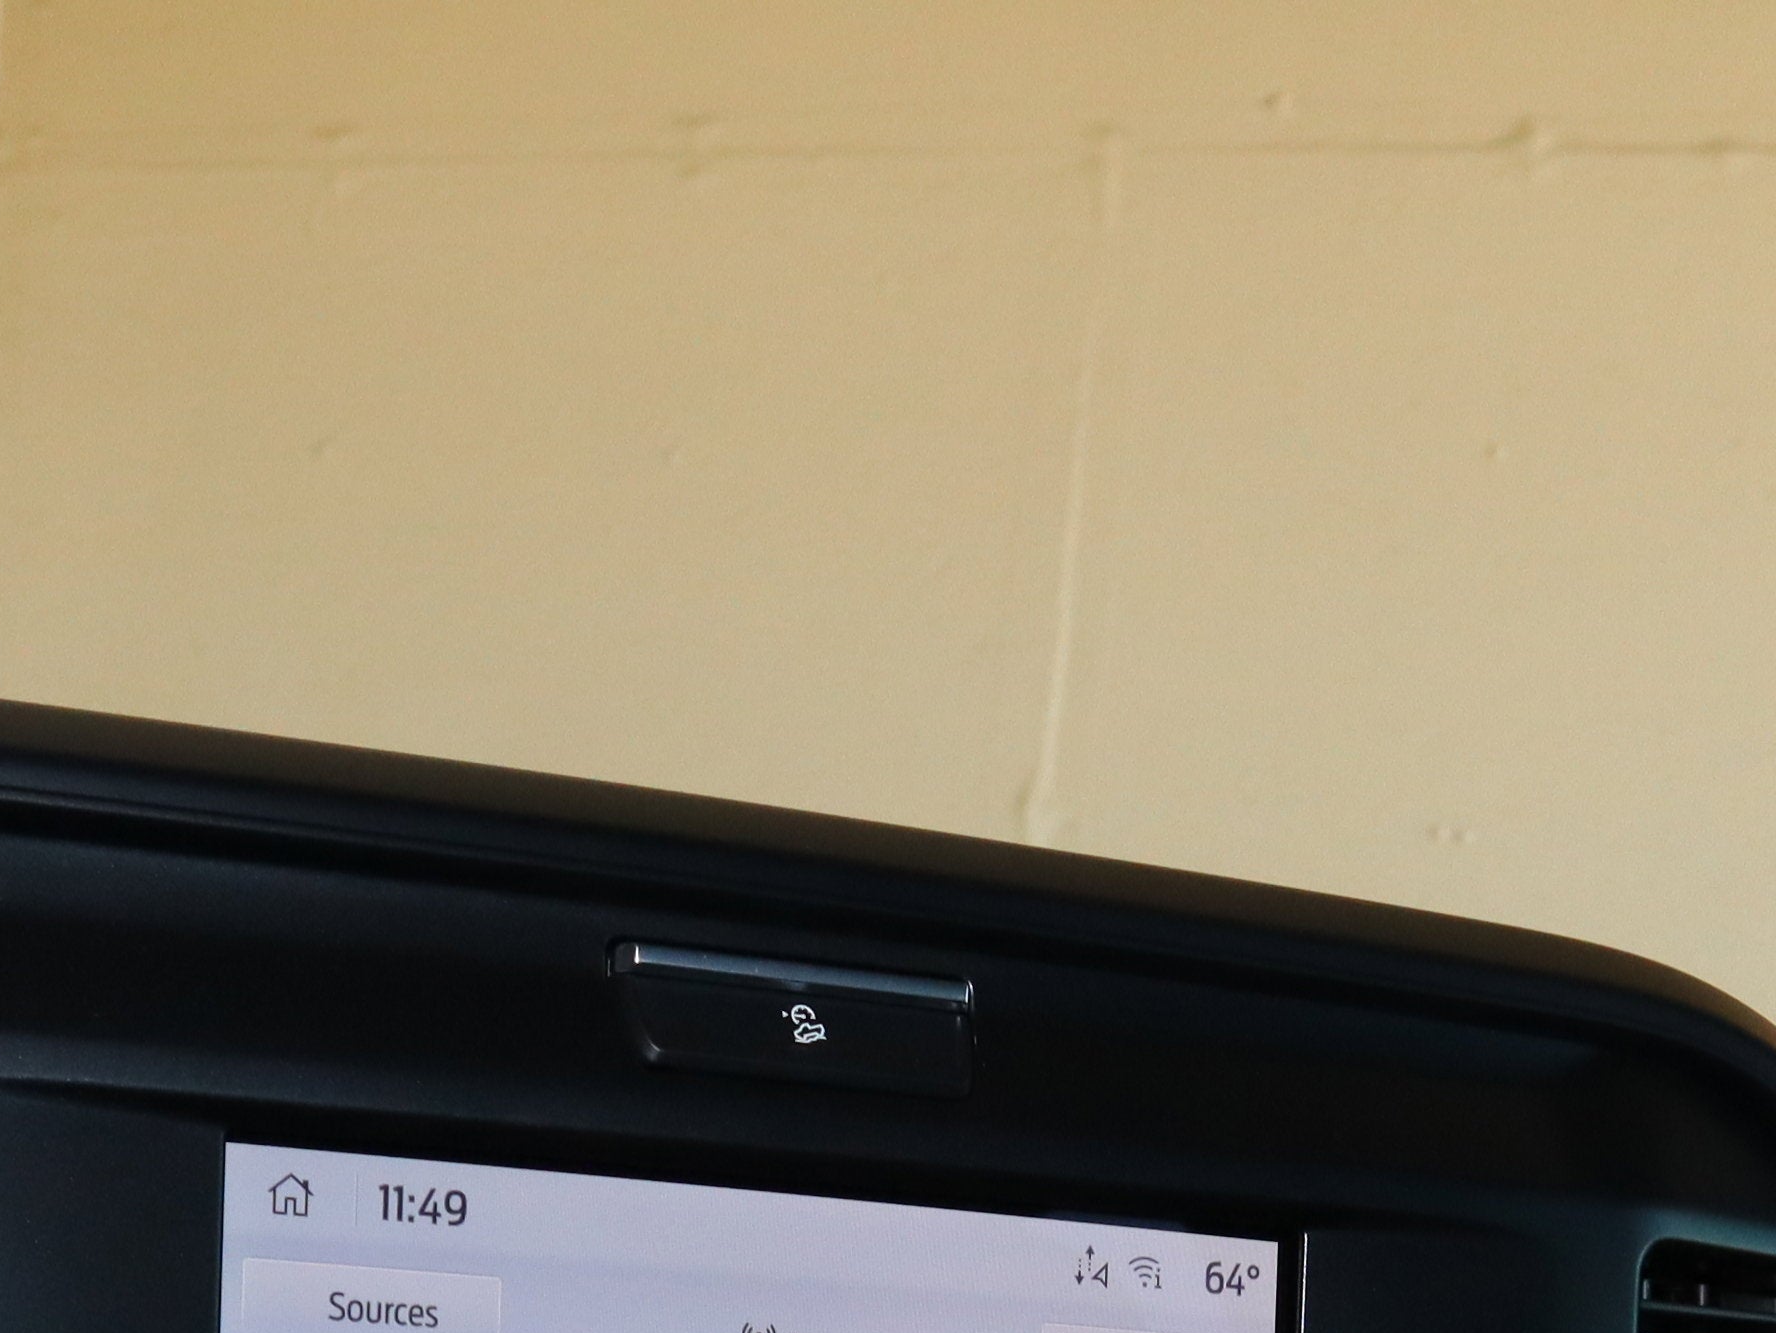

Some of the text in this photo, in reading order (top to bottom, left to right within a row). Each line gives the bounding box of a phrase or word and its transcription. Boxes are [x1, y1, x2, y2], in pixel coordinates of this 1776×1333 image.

[378, 1183, 468, 1227] 11:49
[1205, 1261, 1260, 1297] 64°
[328, 1291, 439, 1329] Sources
